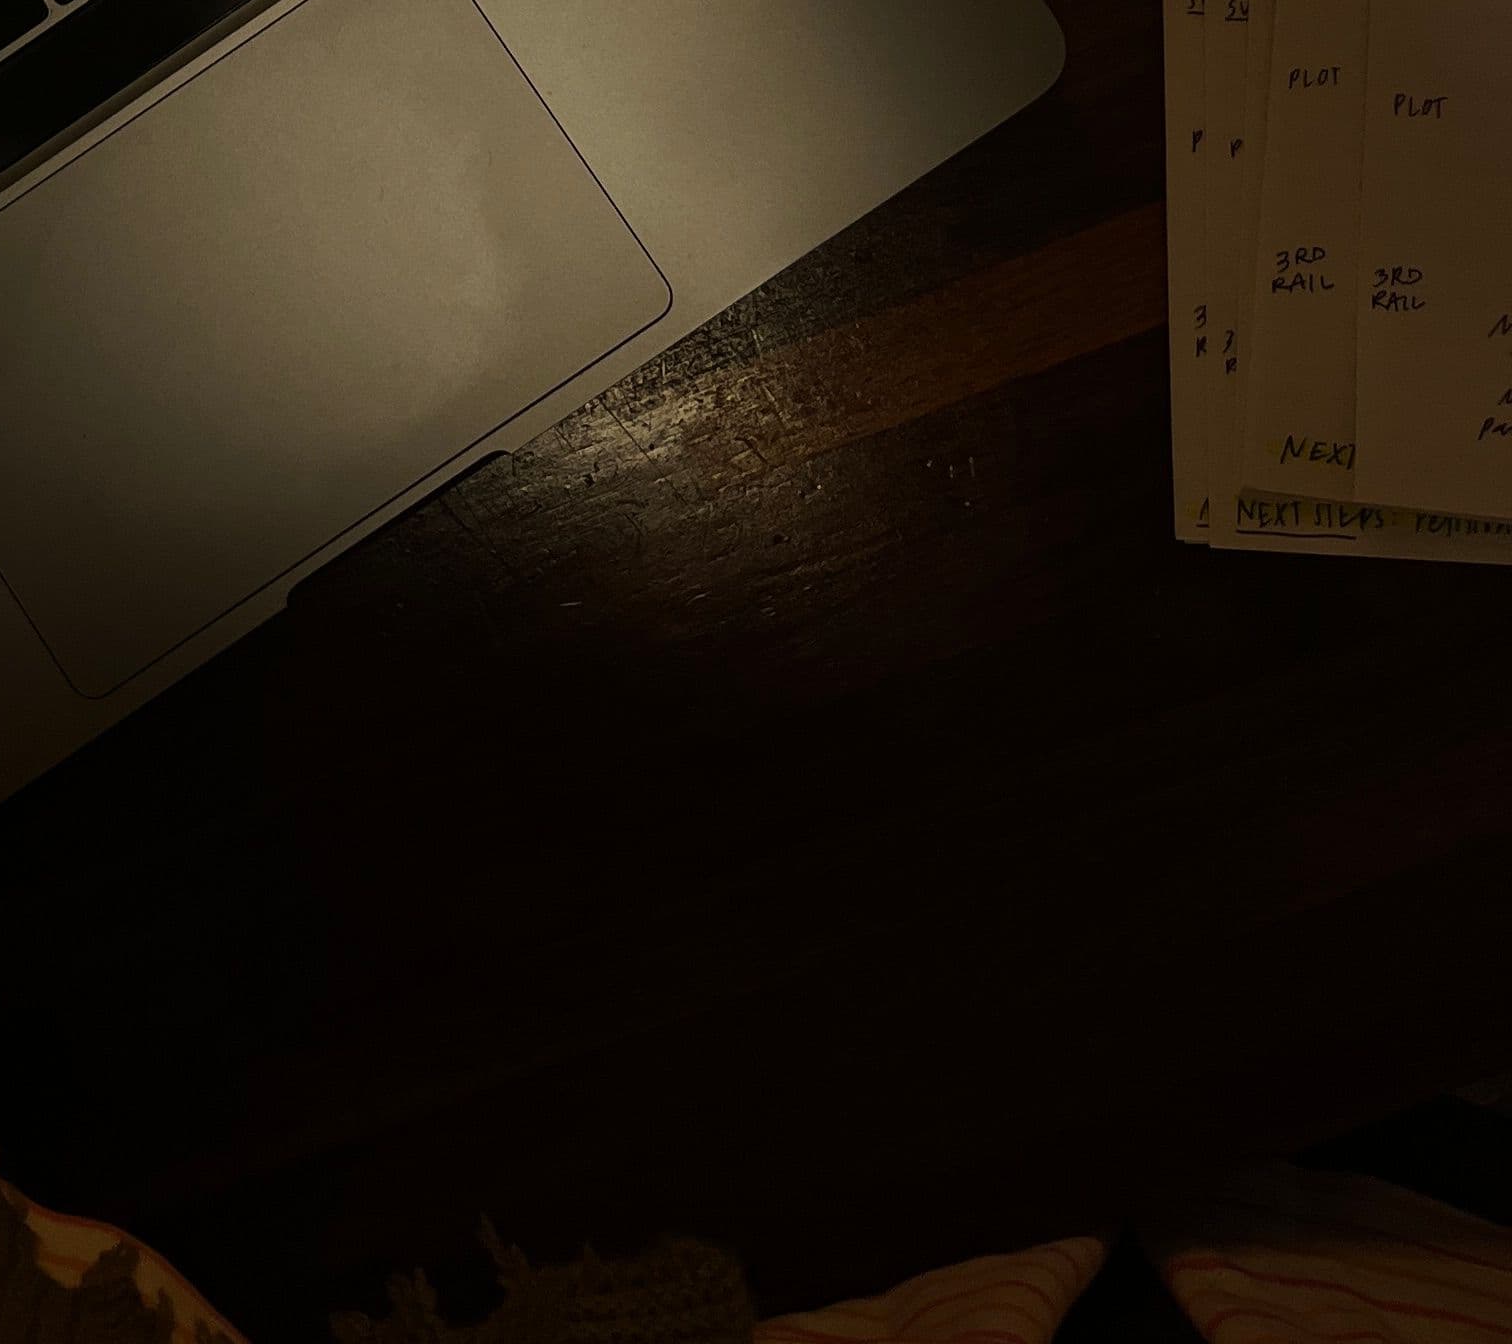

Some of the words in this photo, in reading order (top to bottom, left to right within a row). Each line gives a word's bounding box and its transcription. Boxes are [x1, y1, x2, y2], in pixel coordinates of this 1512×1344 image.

[1288, 66, 1341, 89] PLOT
[1393, 93, 1449, 119] PLOT
[1276, 247, 1326, 273] 3RD
[1272, 273, 1335, 294] RAIL
[1372, 266, 1423, 288] 3RD
[1371, 290, 1426, 312] RAIL
[1237, 499, 1303, 528] NEXT
